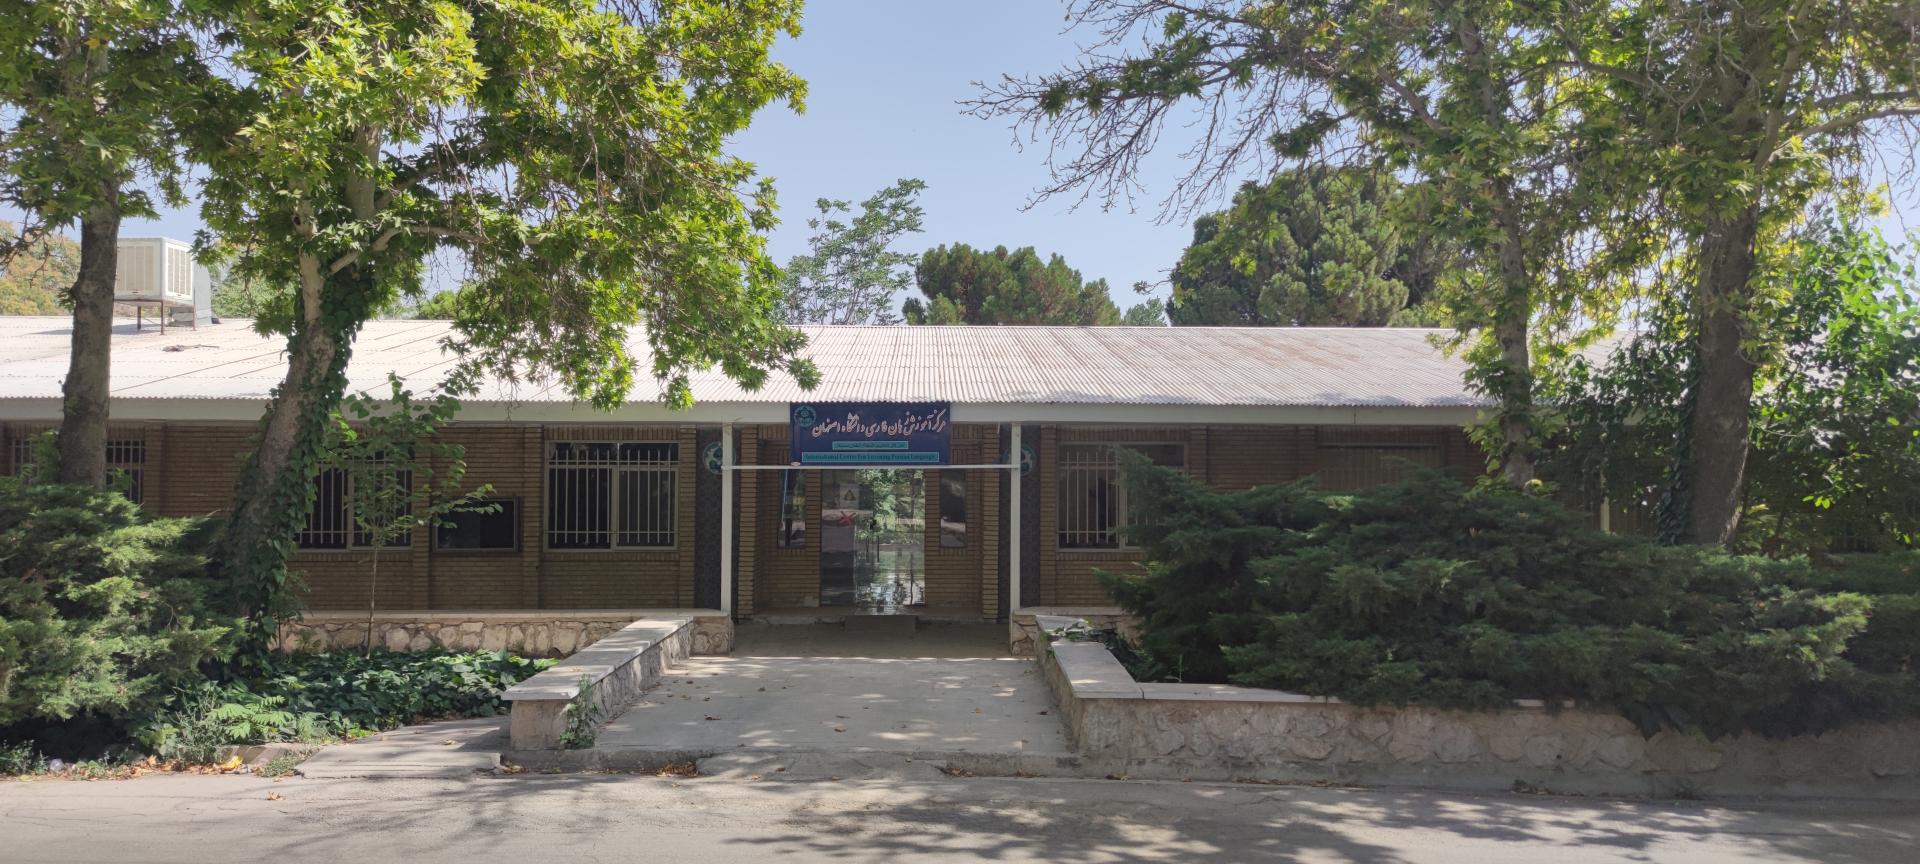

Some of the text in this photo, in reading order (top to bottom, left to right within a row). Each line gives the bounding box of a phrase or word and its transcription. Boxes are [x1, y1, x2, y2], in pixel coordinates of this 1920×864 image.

[812, 408, 946, 437] مرکز آموزش زبان فارسی دانشگاه اصفهان
